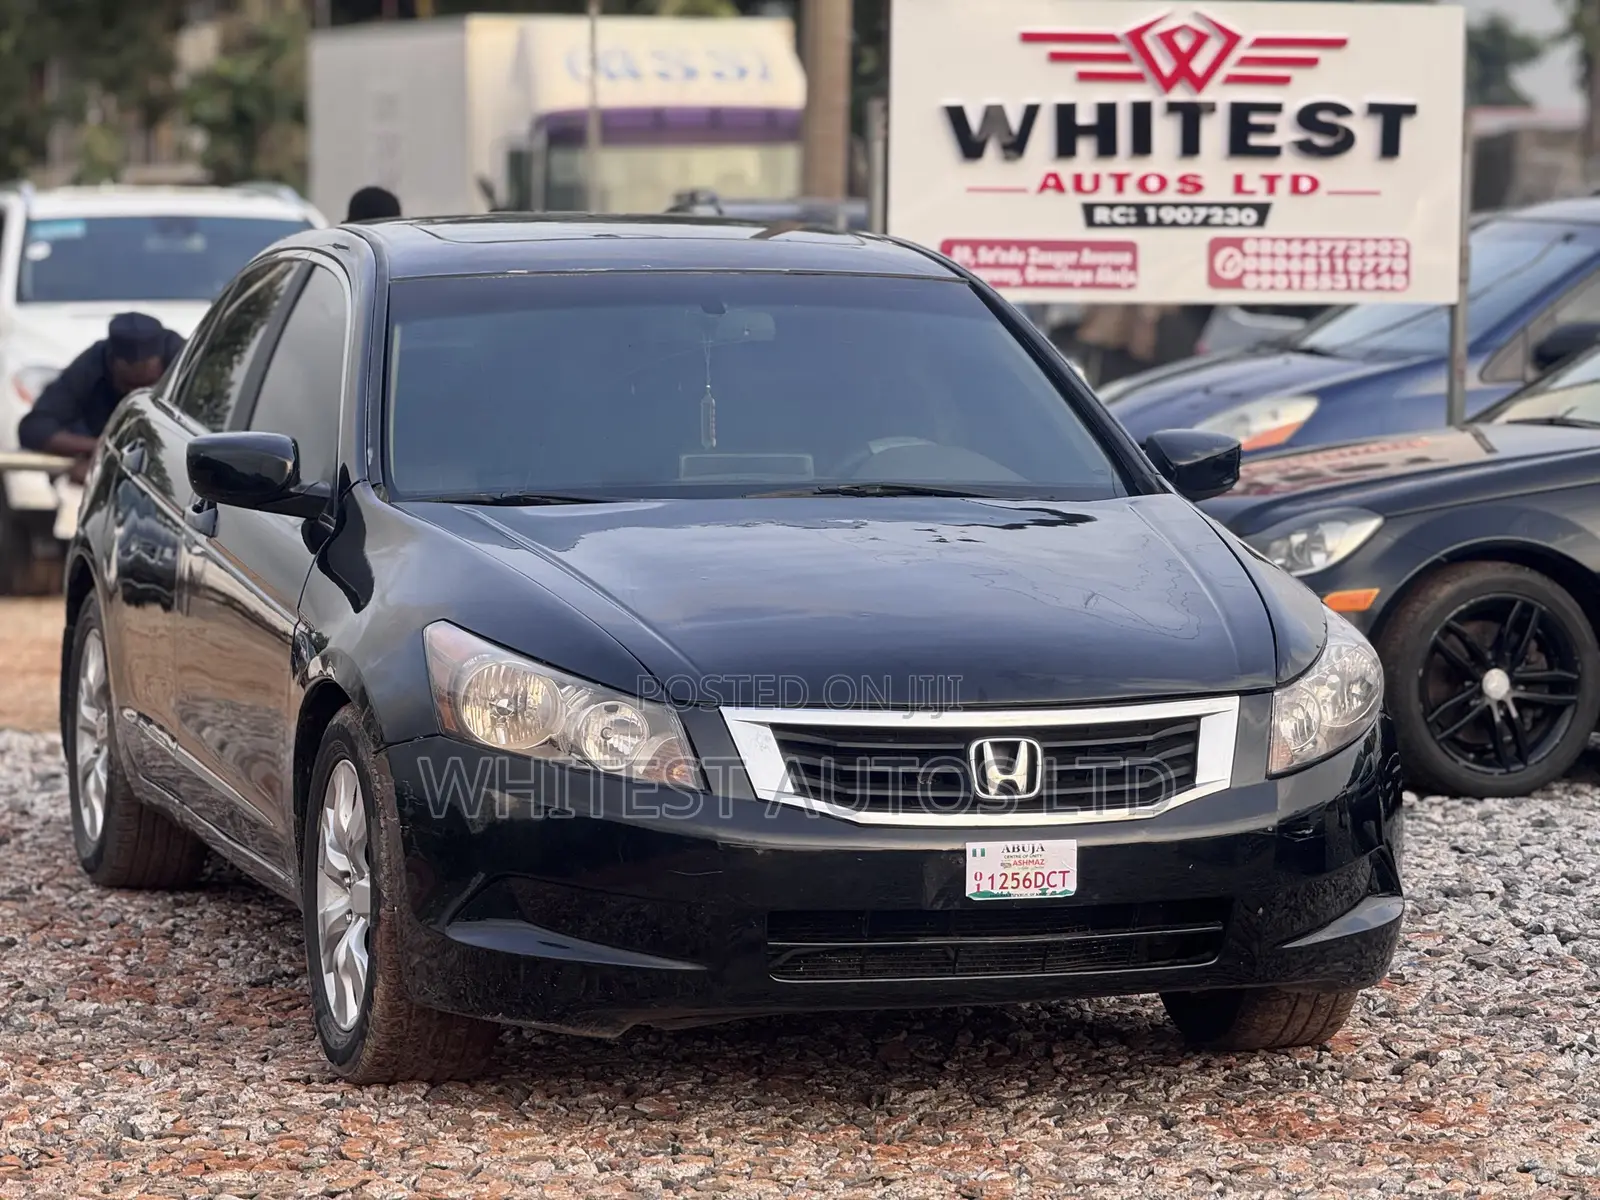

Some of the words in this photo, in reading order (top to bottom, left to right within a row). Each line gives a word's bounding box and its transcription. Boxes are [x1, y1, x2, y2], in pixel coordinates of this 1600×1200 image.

[943, 100, 1418, 162] WHITEST
[1036, 172, 1205, 195] AUTOS
[1233, 173, 1321, 196] LTD
[1093, 205, 1137, 226] RC:
[1145, 206, 1258, 226] 1907230
[1001, 843, 1045, 854] ABUJA
[1012, 858, 1045, 866] ASHMAZ
[987, 870, 1071, 891] 1256DCT
